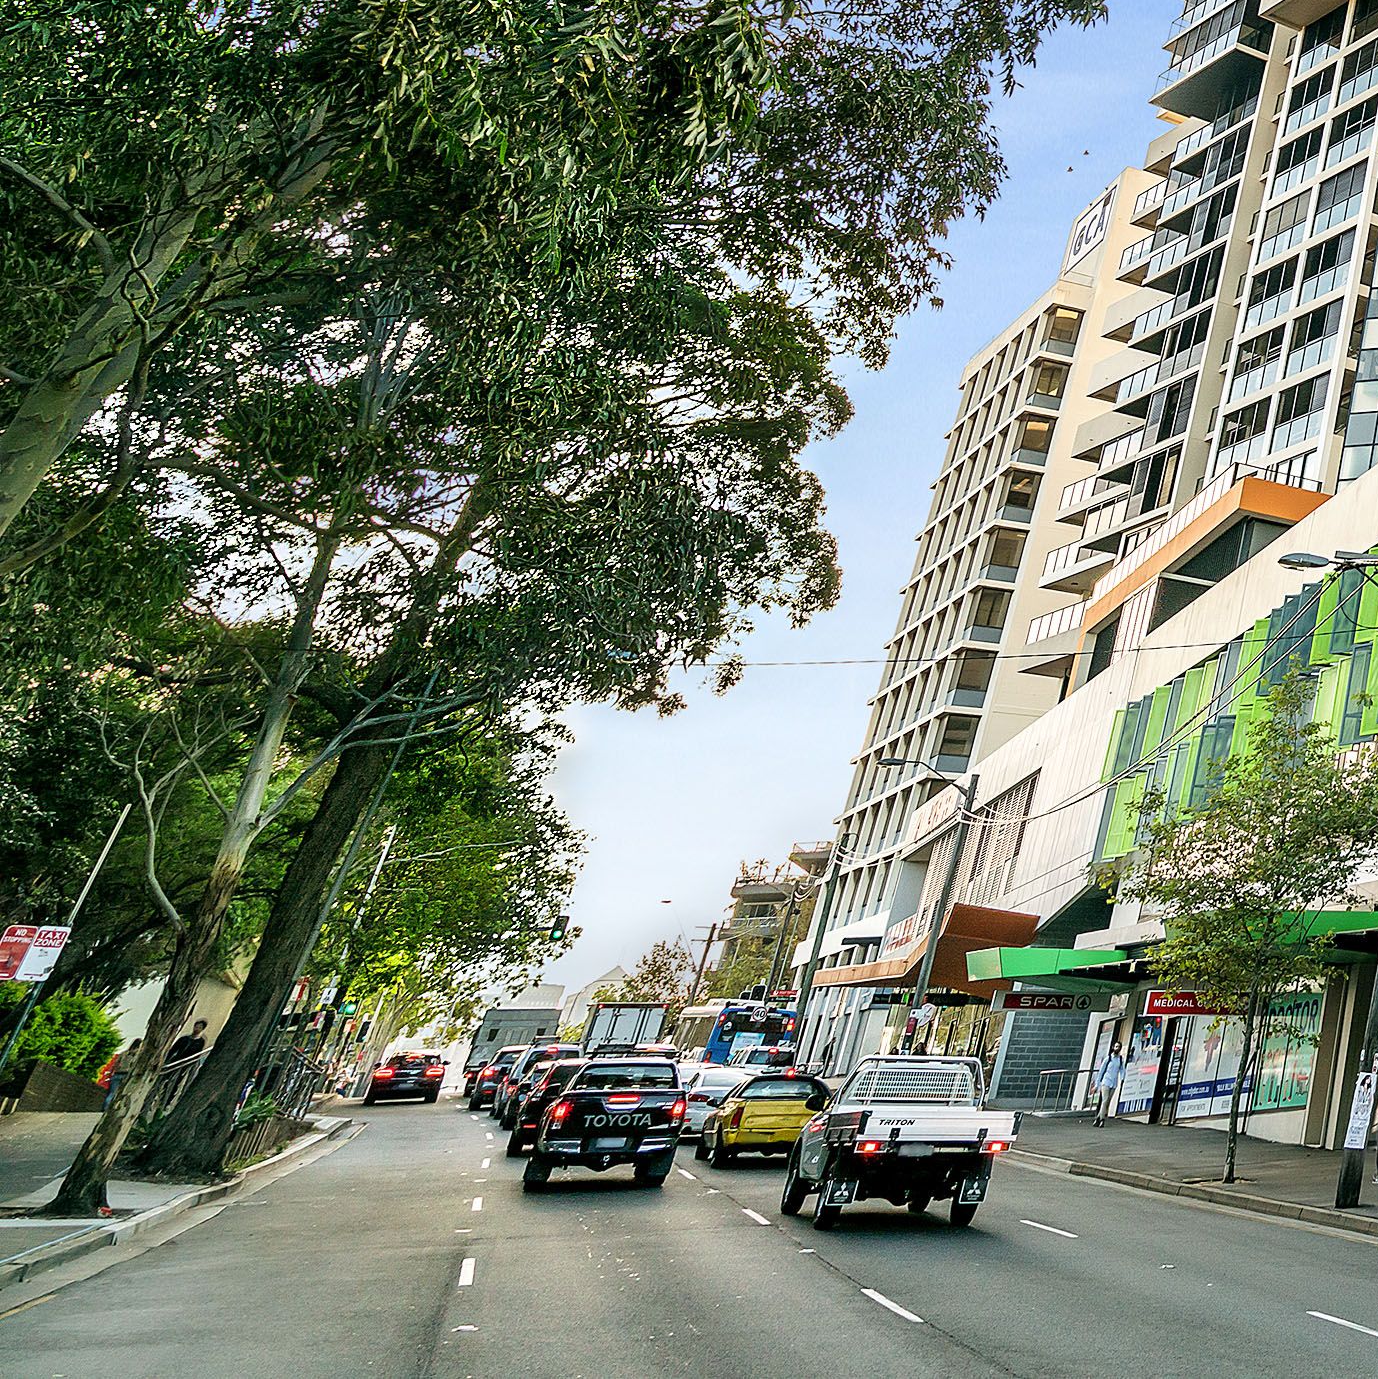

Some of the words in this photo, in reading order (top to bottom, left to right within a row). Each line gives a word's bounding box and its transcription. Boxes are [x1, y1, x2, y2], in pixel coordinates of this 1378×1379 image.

[14, 929, 28, 937] NO
[40, 931, 67, 940] TAXI
[34, 939, 61, 947] ZONE
[1019, 996, 1073, 1007] SPAR
[1153, 998, 1195, 1008] MEDICAL
[754, 1010, 766, 1018] 40
[583, 1113, 652, 1127] TOYOTA
